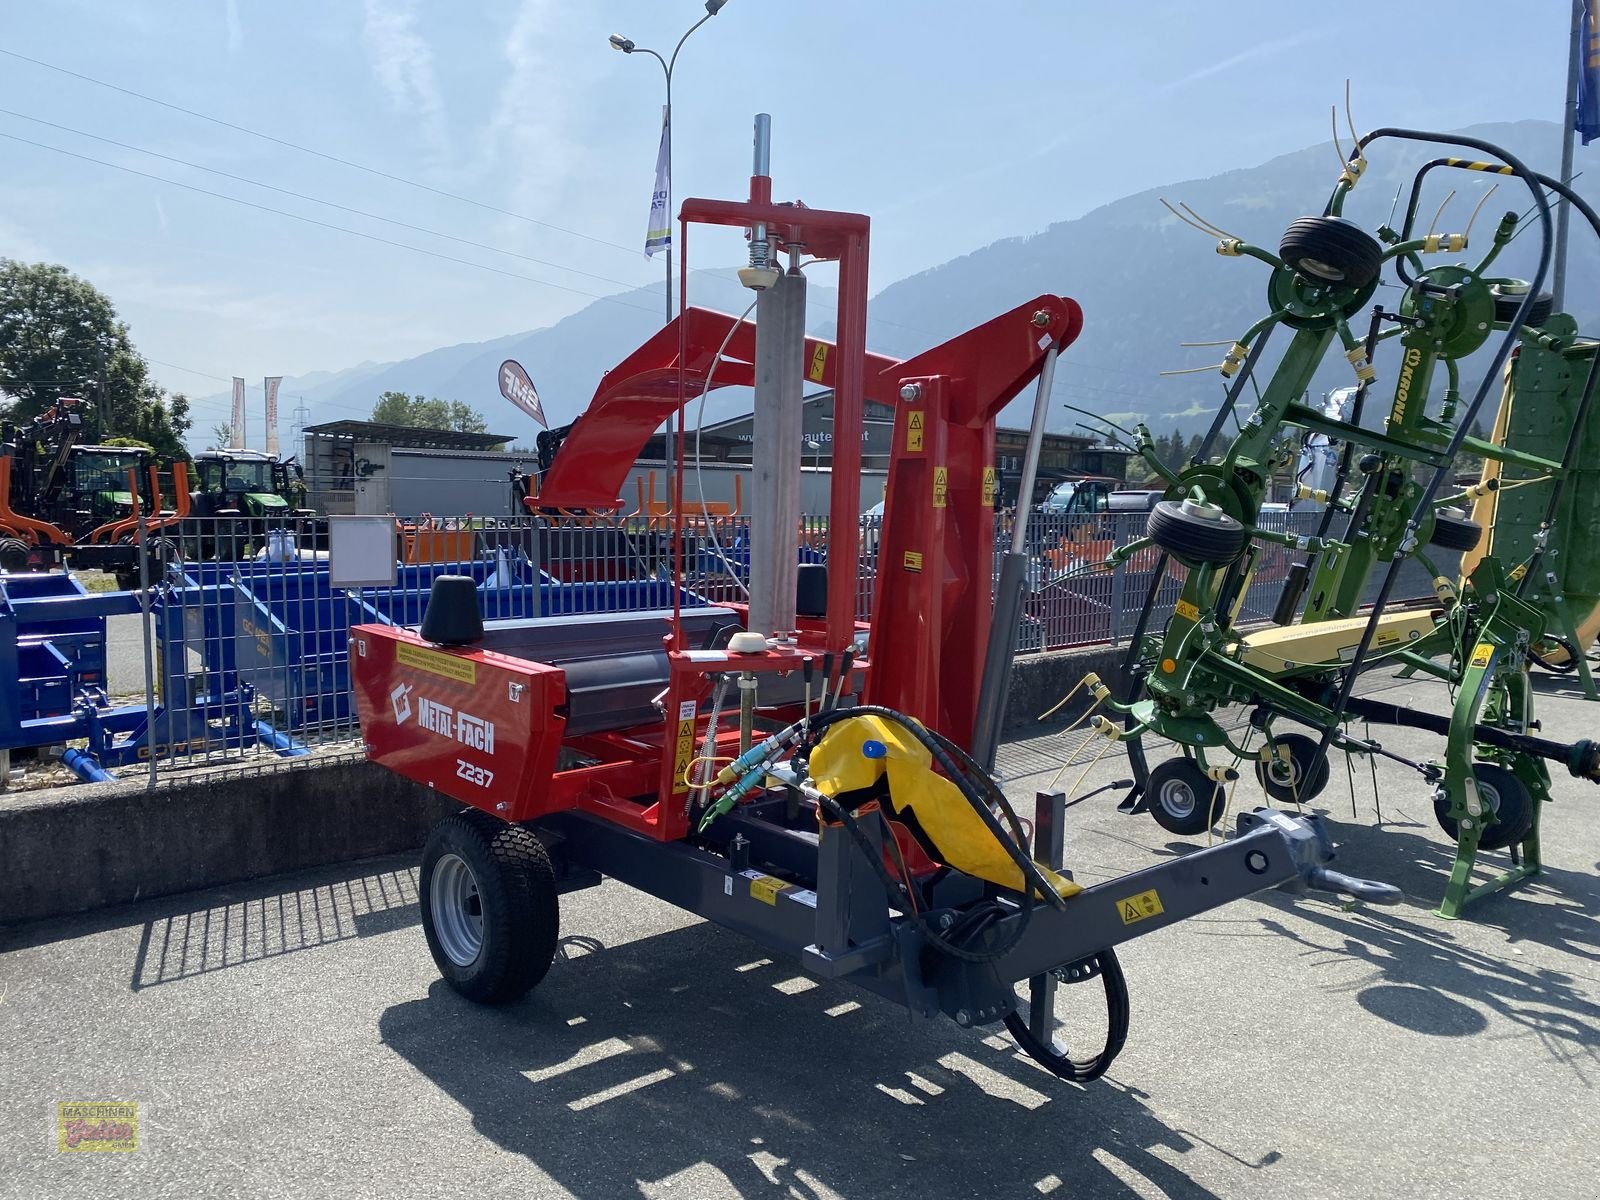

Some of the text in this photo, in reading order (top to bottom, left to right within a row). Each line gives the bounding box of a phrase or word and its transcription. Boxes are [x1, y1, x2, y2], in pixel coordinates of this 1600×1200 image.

[1393, 364, 1413, 424] KRONE
[418, 697, 495, 755] METAL-FACH
[456, 758, 494, 788] Z237
